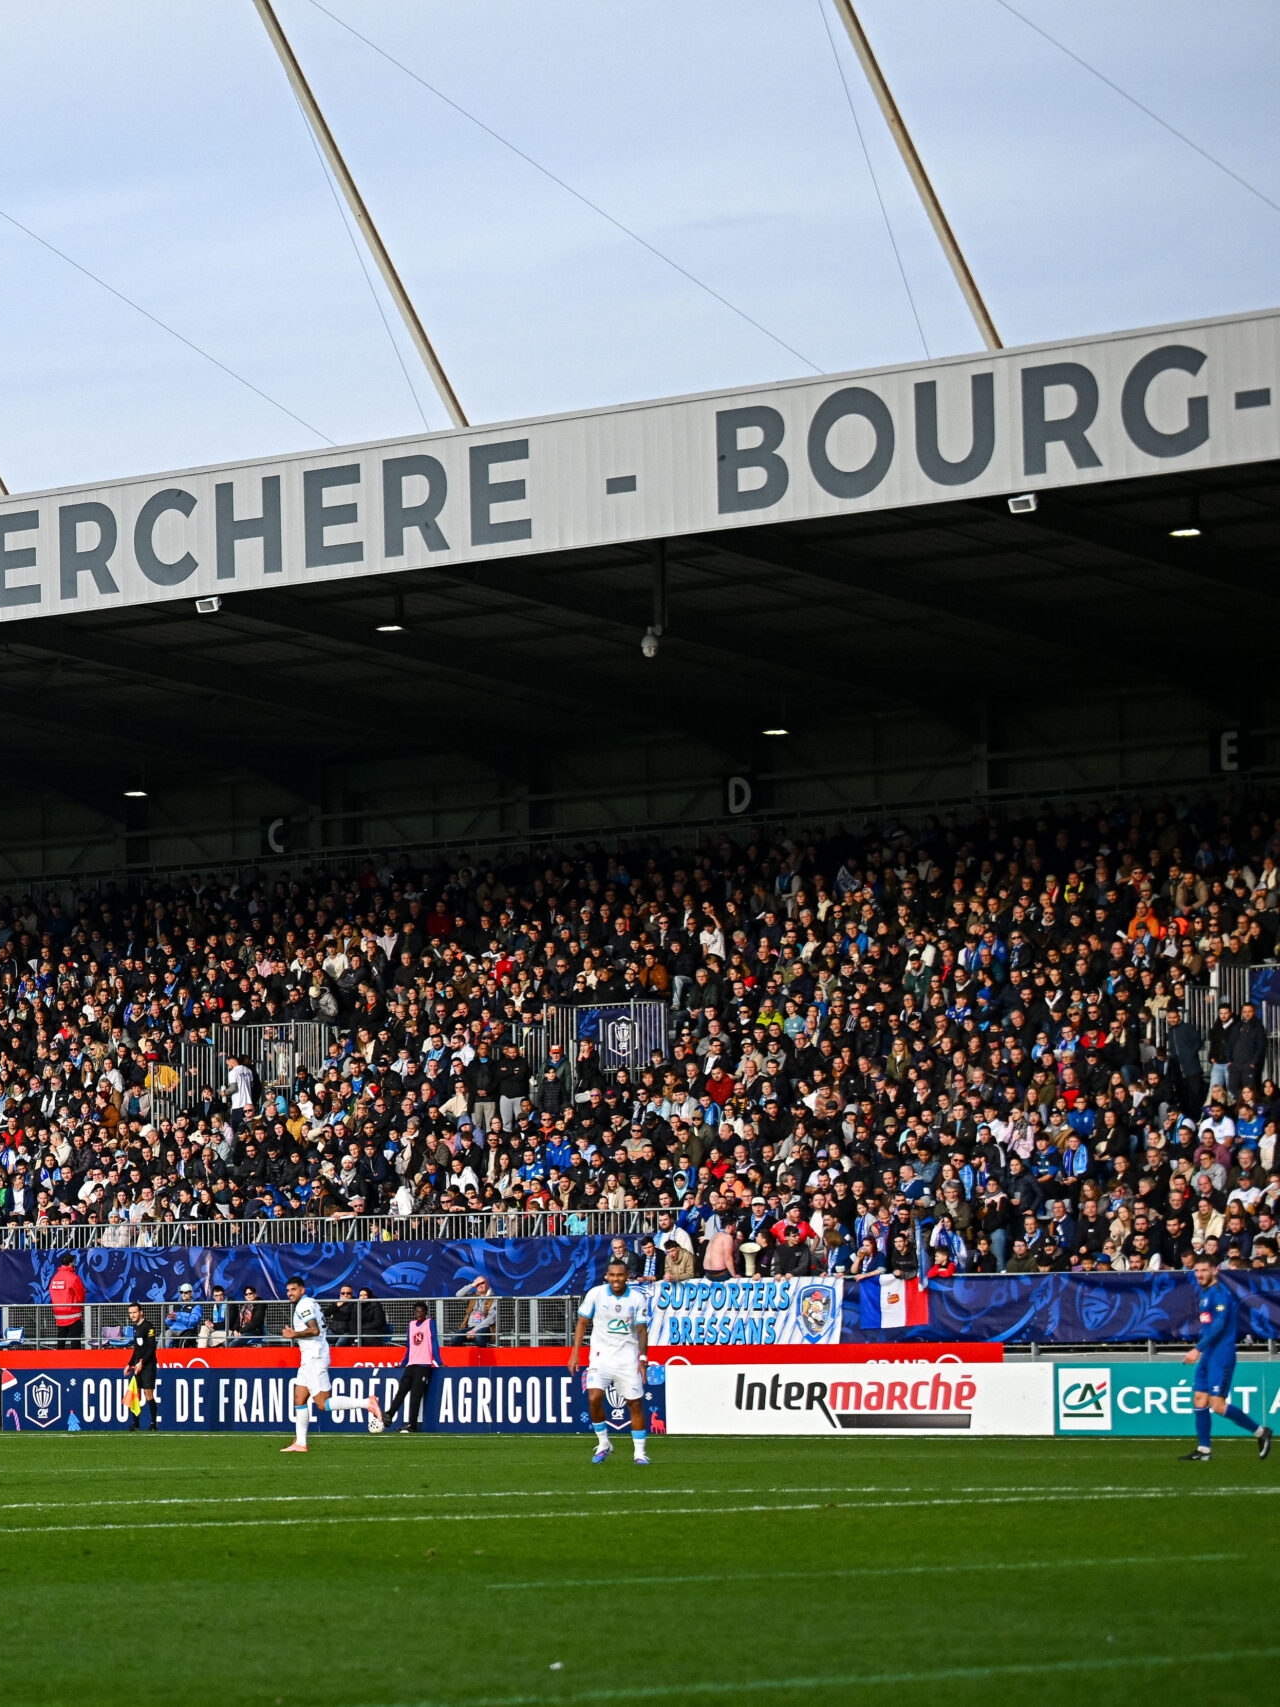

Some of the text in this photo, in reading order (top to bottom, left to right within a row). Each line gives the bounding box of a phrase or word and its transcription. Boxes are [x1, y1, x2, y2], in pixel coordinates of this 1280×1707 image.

[1221, 731, 1238, 770] E
[728, 776, 751, 814] D
[268, 818, 284, 853] C
[657, 1280, 791, 1312] SUPPORTERS
[669, 1316, 777, 1345] BRESSANS
[176, 1378, 205, 1423] DE
[219, 1378, 318, 1423] FRANC
[438, 1376, 574, 1424] AGRICOLE
[1116, 1379, 1258, 1414] CRÉT
